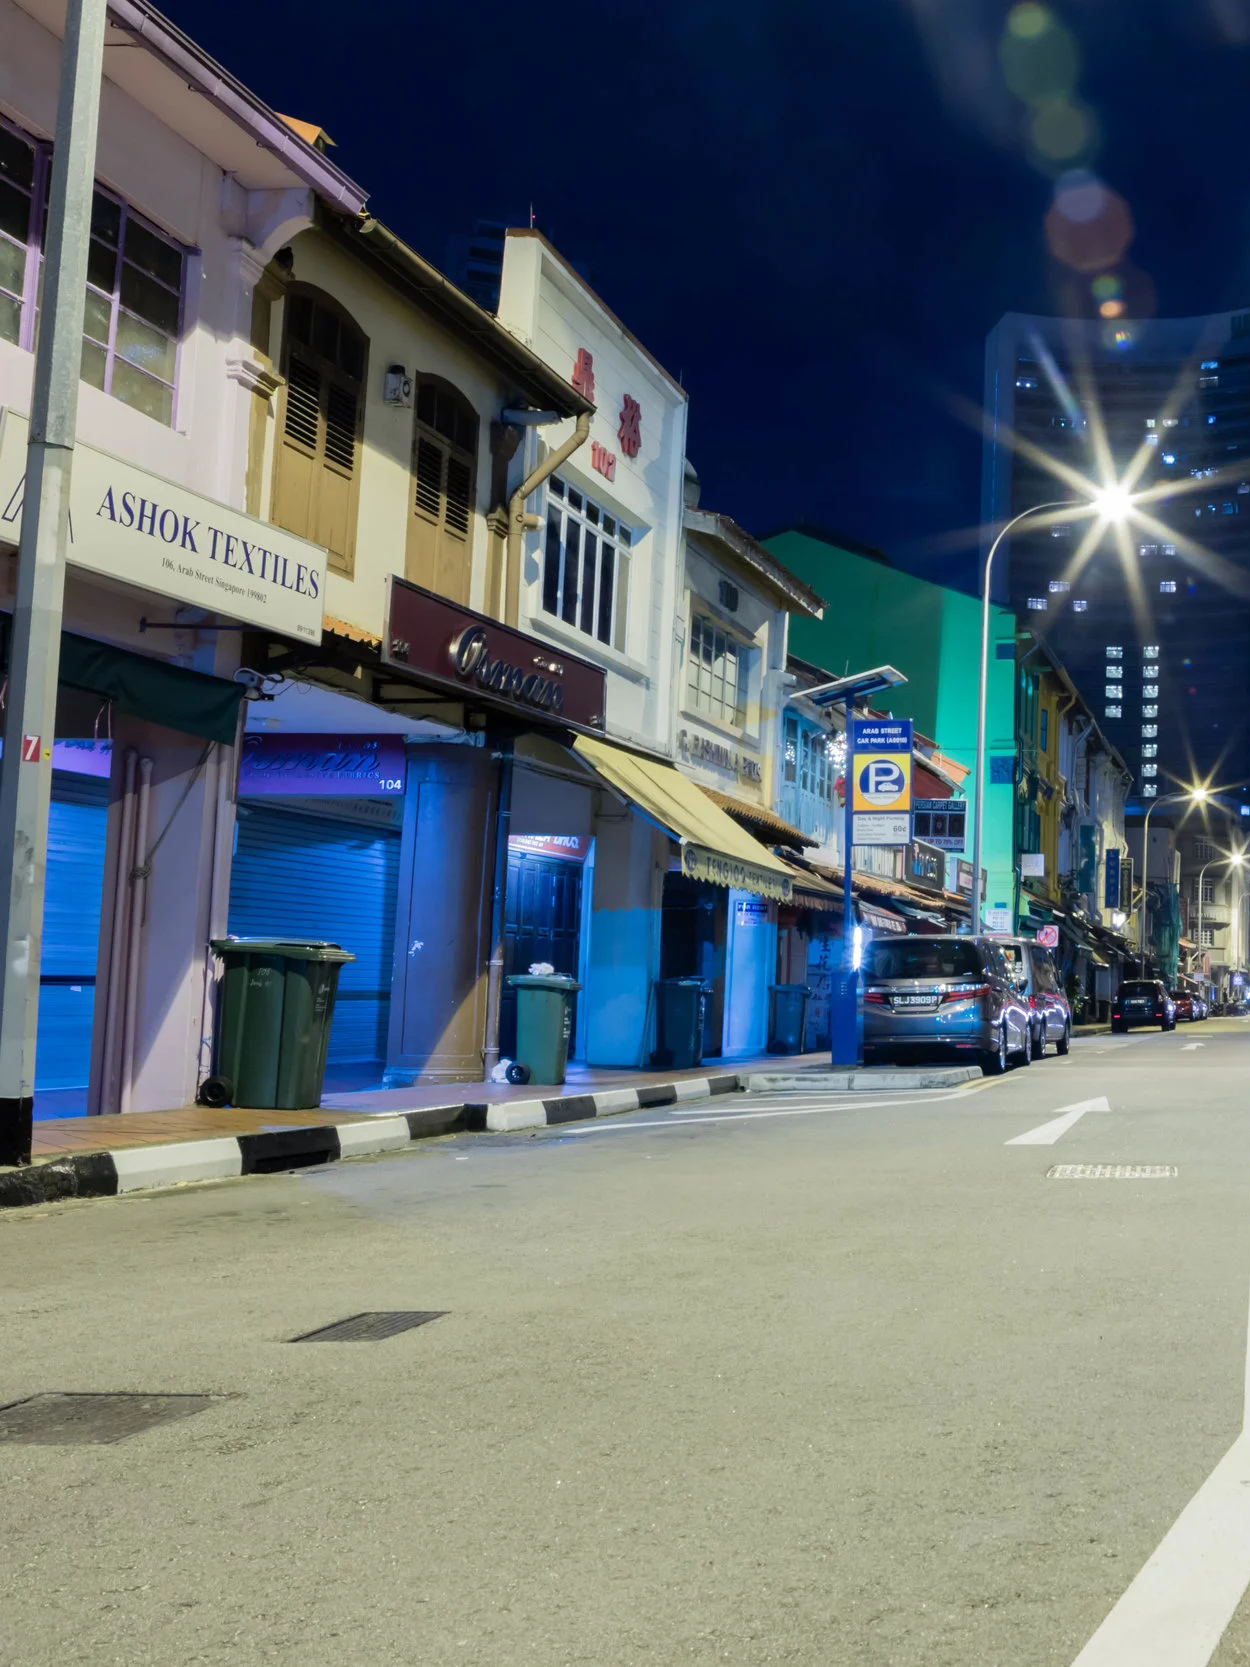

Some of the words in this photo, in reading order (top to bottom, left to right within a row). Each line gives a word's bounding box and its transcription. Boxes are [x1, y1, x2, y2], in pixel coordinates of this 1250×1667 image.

[591, 440, 616, 482] 102
[96, 485, 201, 554] ASHOK
[207, 526, 320, 600] TEXTILES
[161, 557, 175, 571] 106,
[177, 564, 194, 577] Arab
[195, 569, 215, 584] Street
[216, 577, 246, 596] Singapore
[25, 734, 39, 760] 7
[379, 779, 402, 790] 104
[932, 801, 947, 809] CARPET
[893, 996, 938, 1004] SLJ3909P
